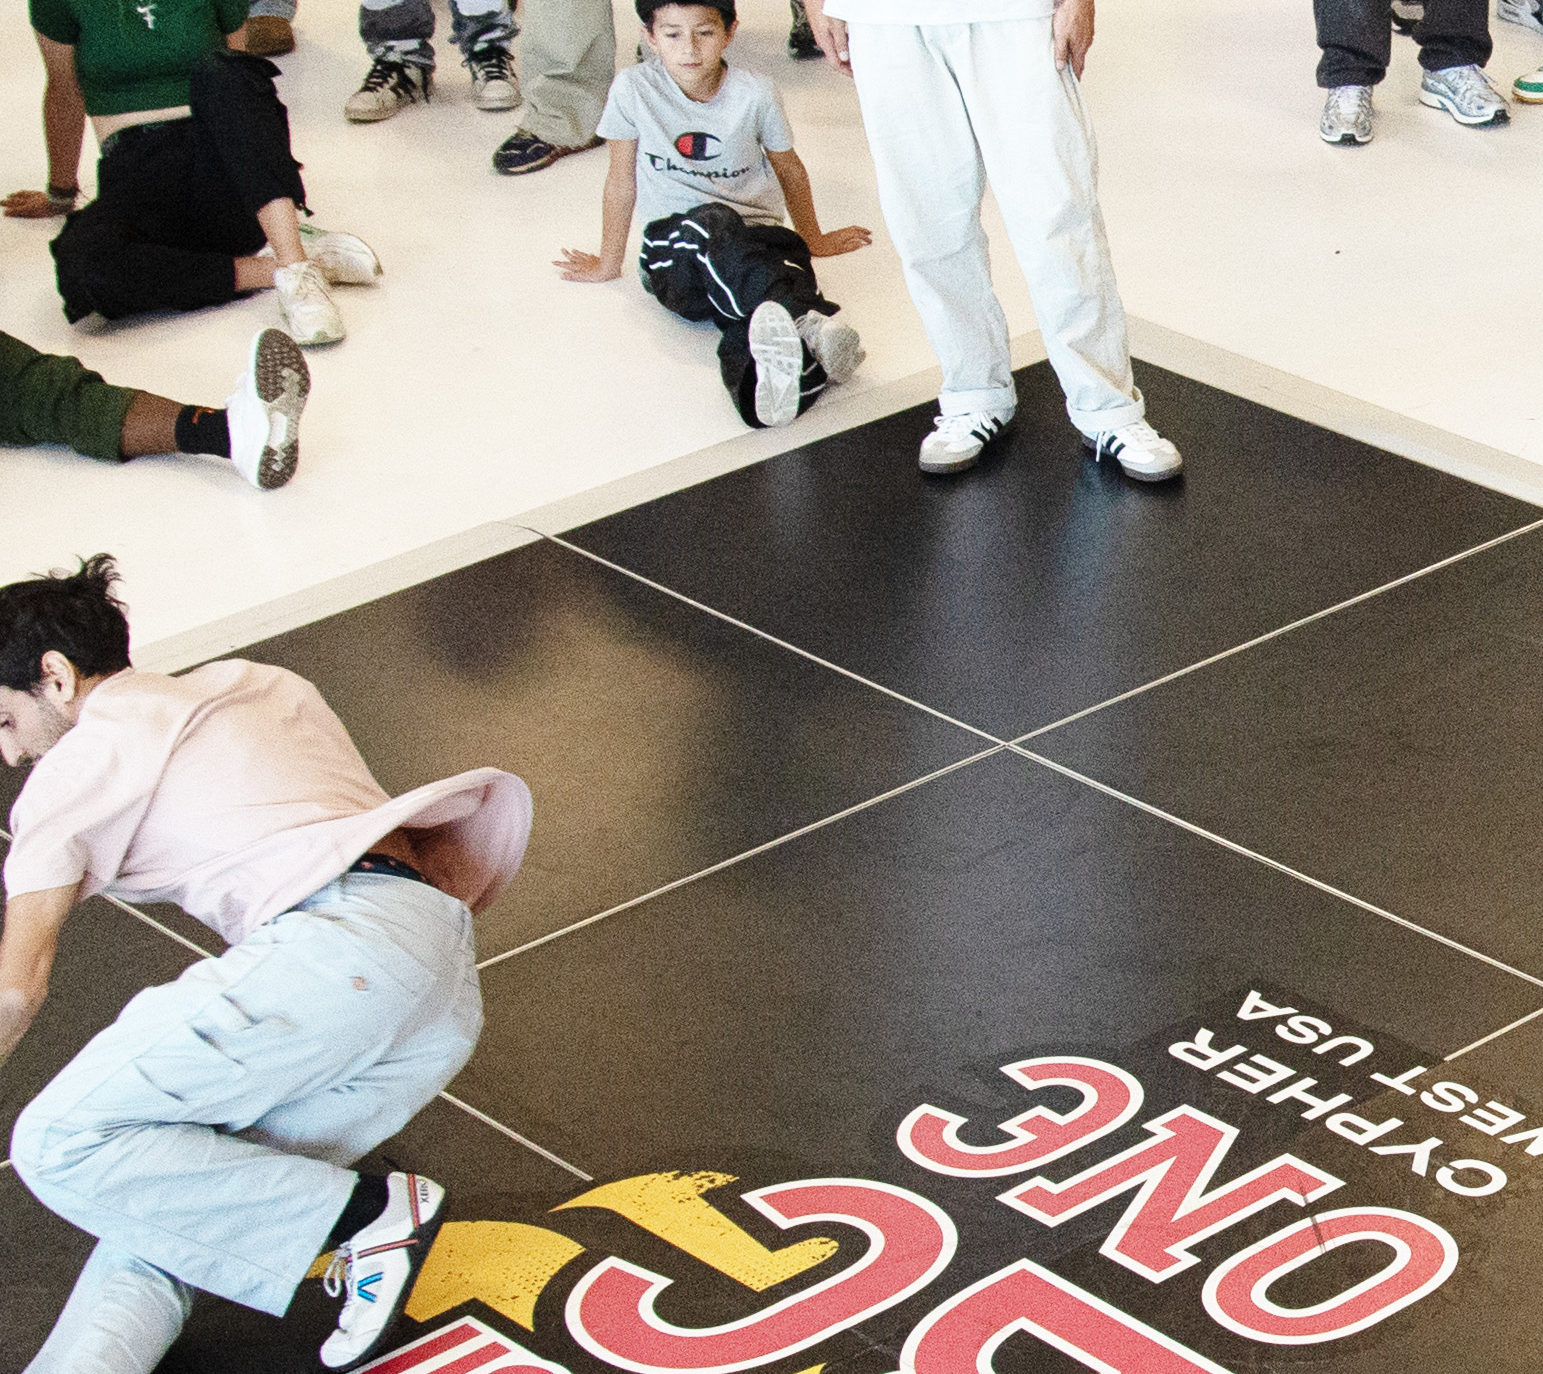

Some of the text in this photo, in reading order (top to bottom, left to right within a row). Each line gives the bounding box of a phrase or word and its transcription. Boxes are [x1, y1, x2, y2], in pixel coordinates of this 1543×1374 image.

[644, 151, 750, 180] Champion
[1237, 990, 1374, 1068] USA
[1167, 1028, 1509, 1199] CYPHER
[895, 1055, 1460, 1347] ONE
